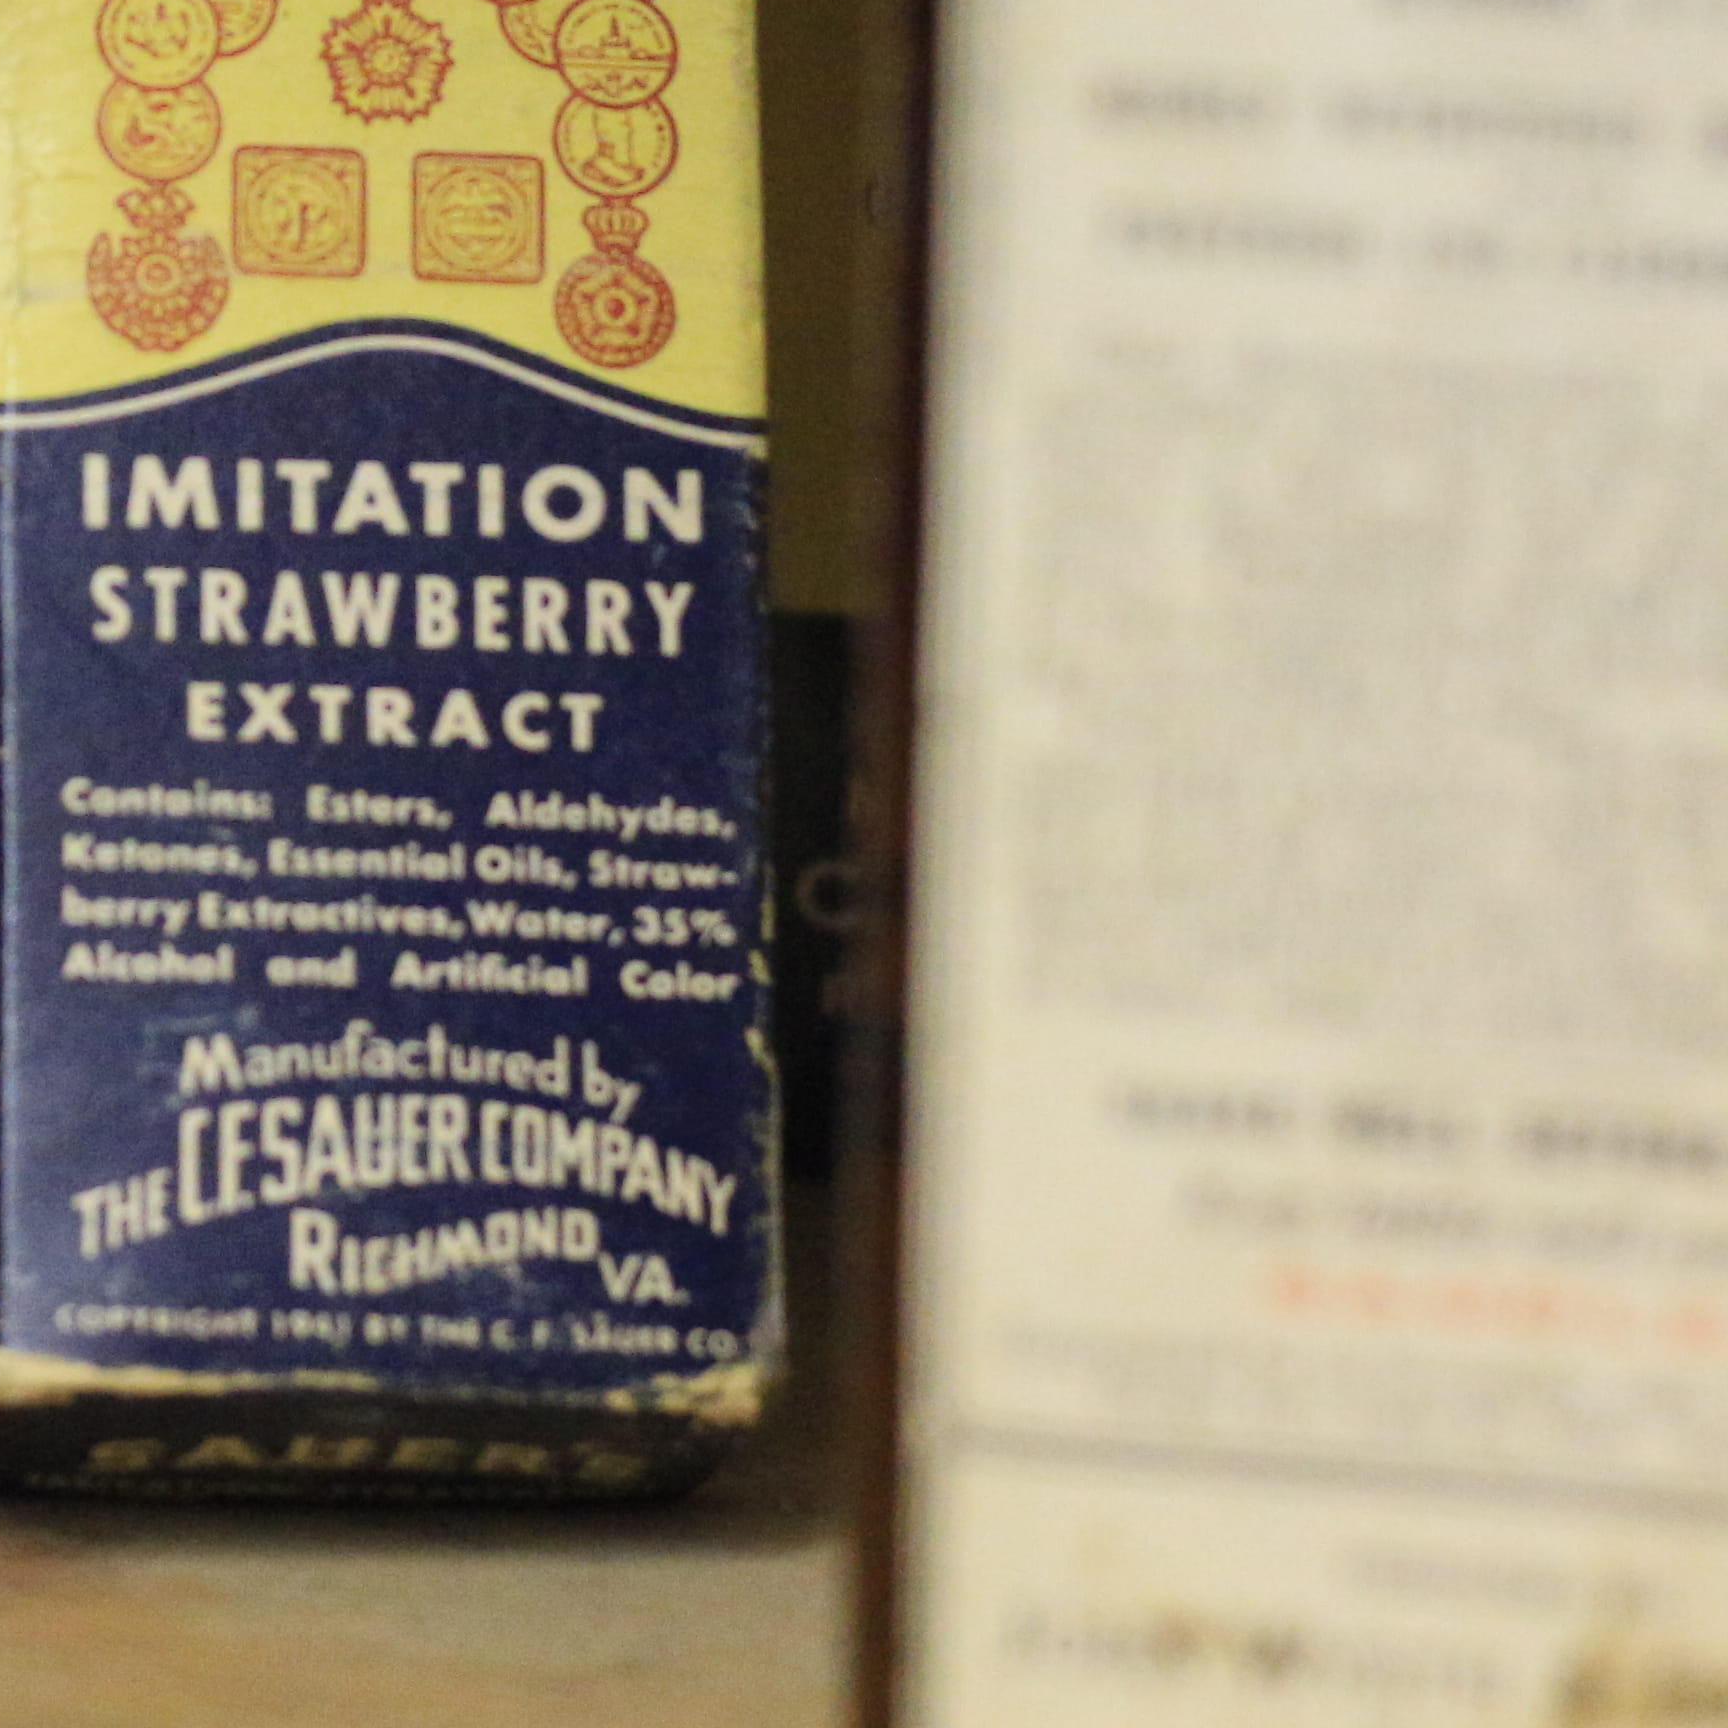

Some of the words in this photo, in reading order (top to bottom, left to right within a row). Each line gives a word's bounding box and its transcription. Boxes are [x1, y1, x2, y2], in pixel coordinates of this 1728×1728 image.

[80, 453, 706, 543] IMITATION
[89, 565, 696, 657] STRAWBERRY
[186, 681, 605, 753] EXTRACT
[61, 776, 274, 820] Contains:
[306, 783, 454, 832] Esters,
[484, 789, 737, 842] Aldehydes,
[61, 832, 258, 880] Ketones,
[267, 838, 467, 884] Essential
[474, 842, 578, 891] Oils,
[588, 848, 740, 891] Straw-
[61, 885, 192, 938] berry
[197, 890, 466, 944] Extractives,
[465, 900, 626, 948] Water,
[632, 905, 737, 947] 35%
[61, 940, 236, 986] Alcohol
[265, 946, 358, 990] and
[390, 951, 589, 998] Artificial
[619, 959, 740, 1003] Color
[179, 1020, 571, 1097] Manufactured
[581, 1039, 641, 1124] by
[72, 1167, 172, 1260] THE
[479, 1098, 736, 1236] COMPANY
[289, 1204, 601, 1297] RICHMOND
[598, 1252, 690, 1306] VA.
